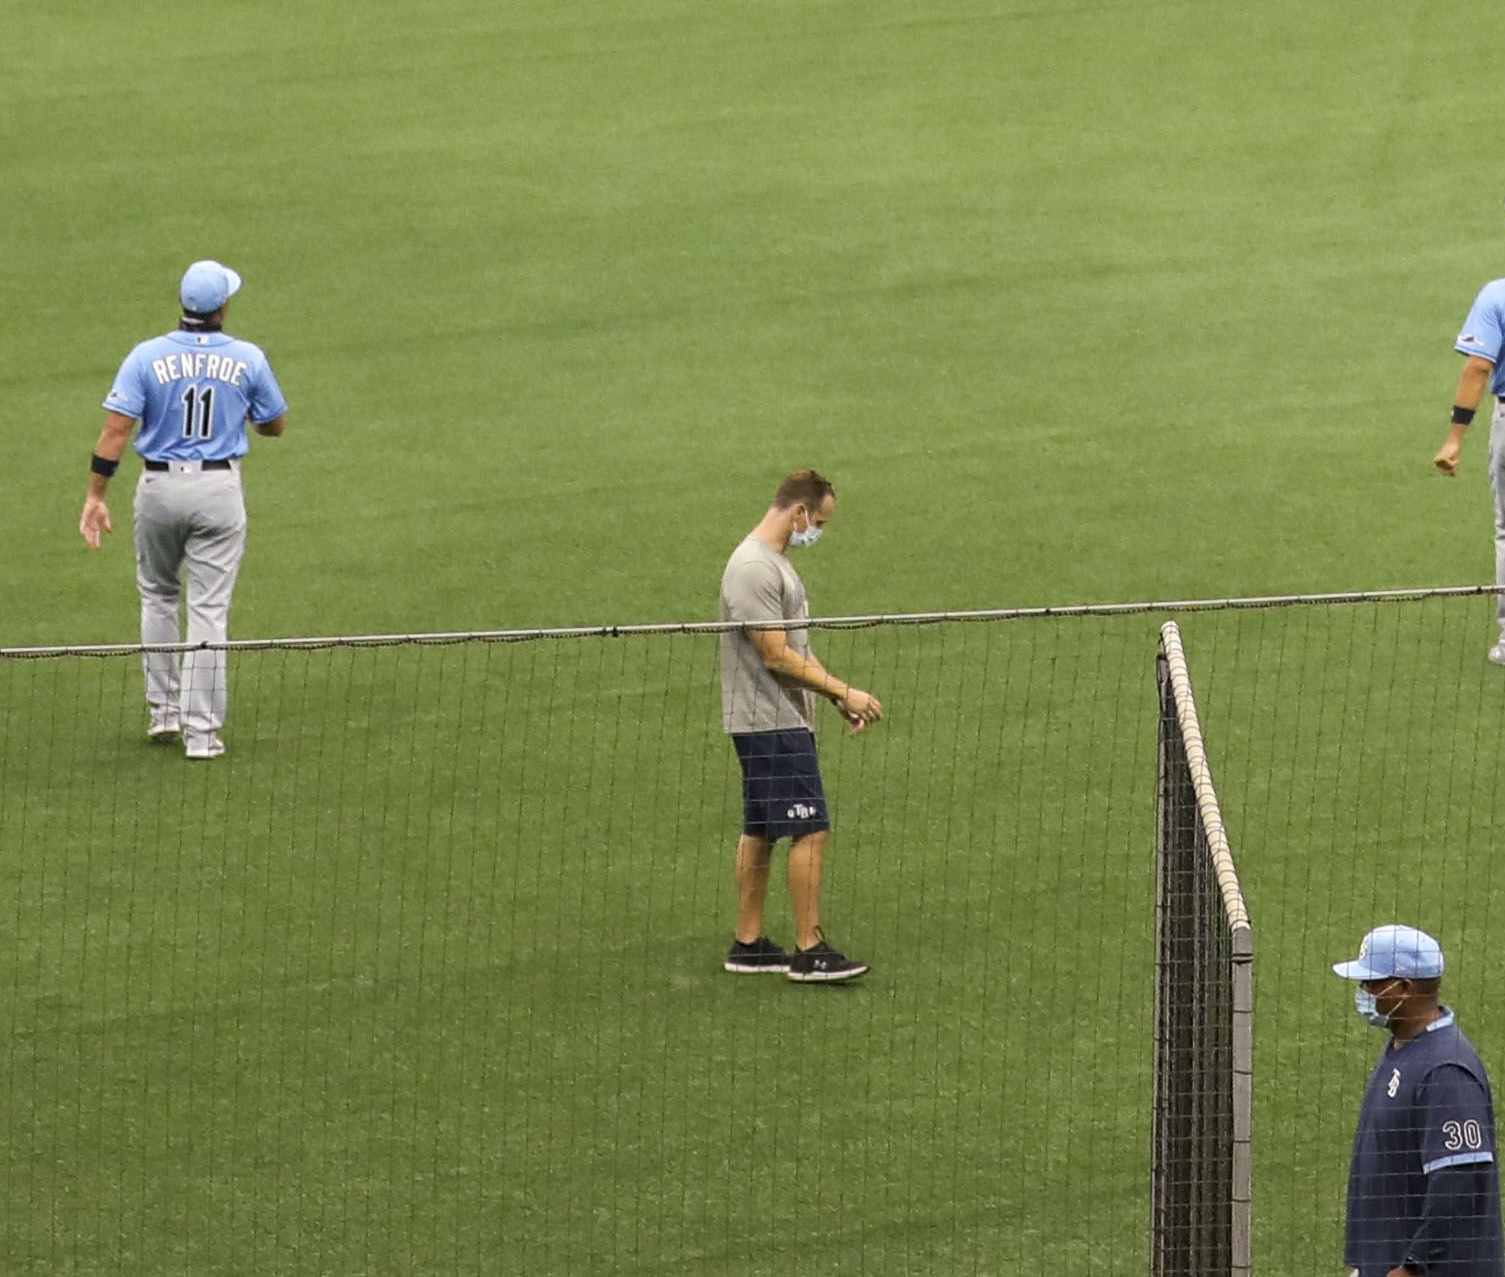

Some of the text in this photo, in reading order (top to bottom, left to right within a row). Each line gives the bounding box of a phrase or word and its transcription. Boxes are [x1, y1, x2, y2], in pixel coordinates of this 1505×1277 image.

[152, 352, 248, 386] RENFROE
[181, 383, 215, 441] 11
[1441, 1118, 1482, 1151] 30
